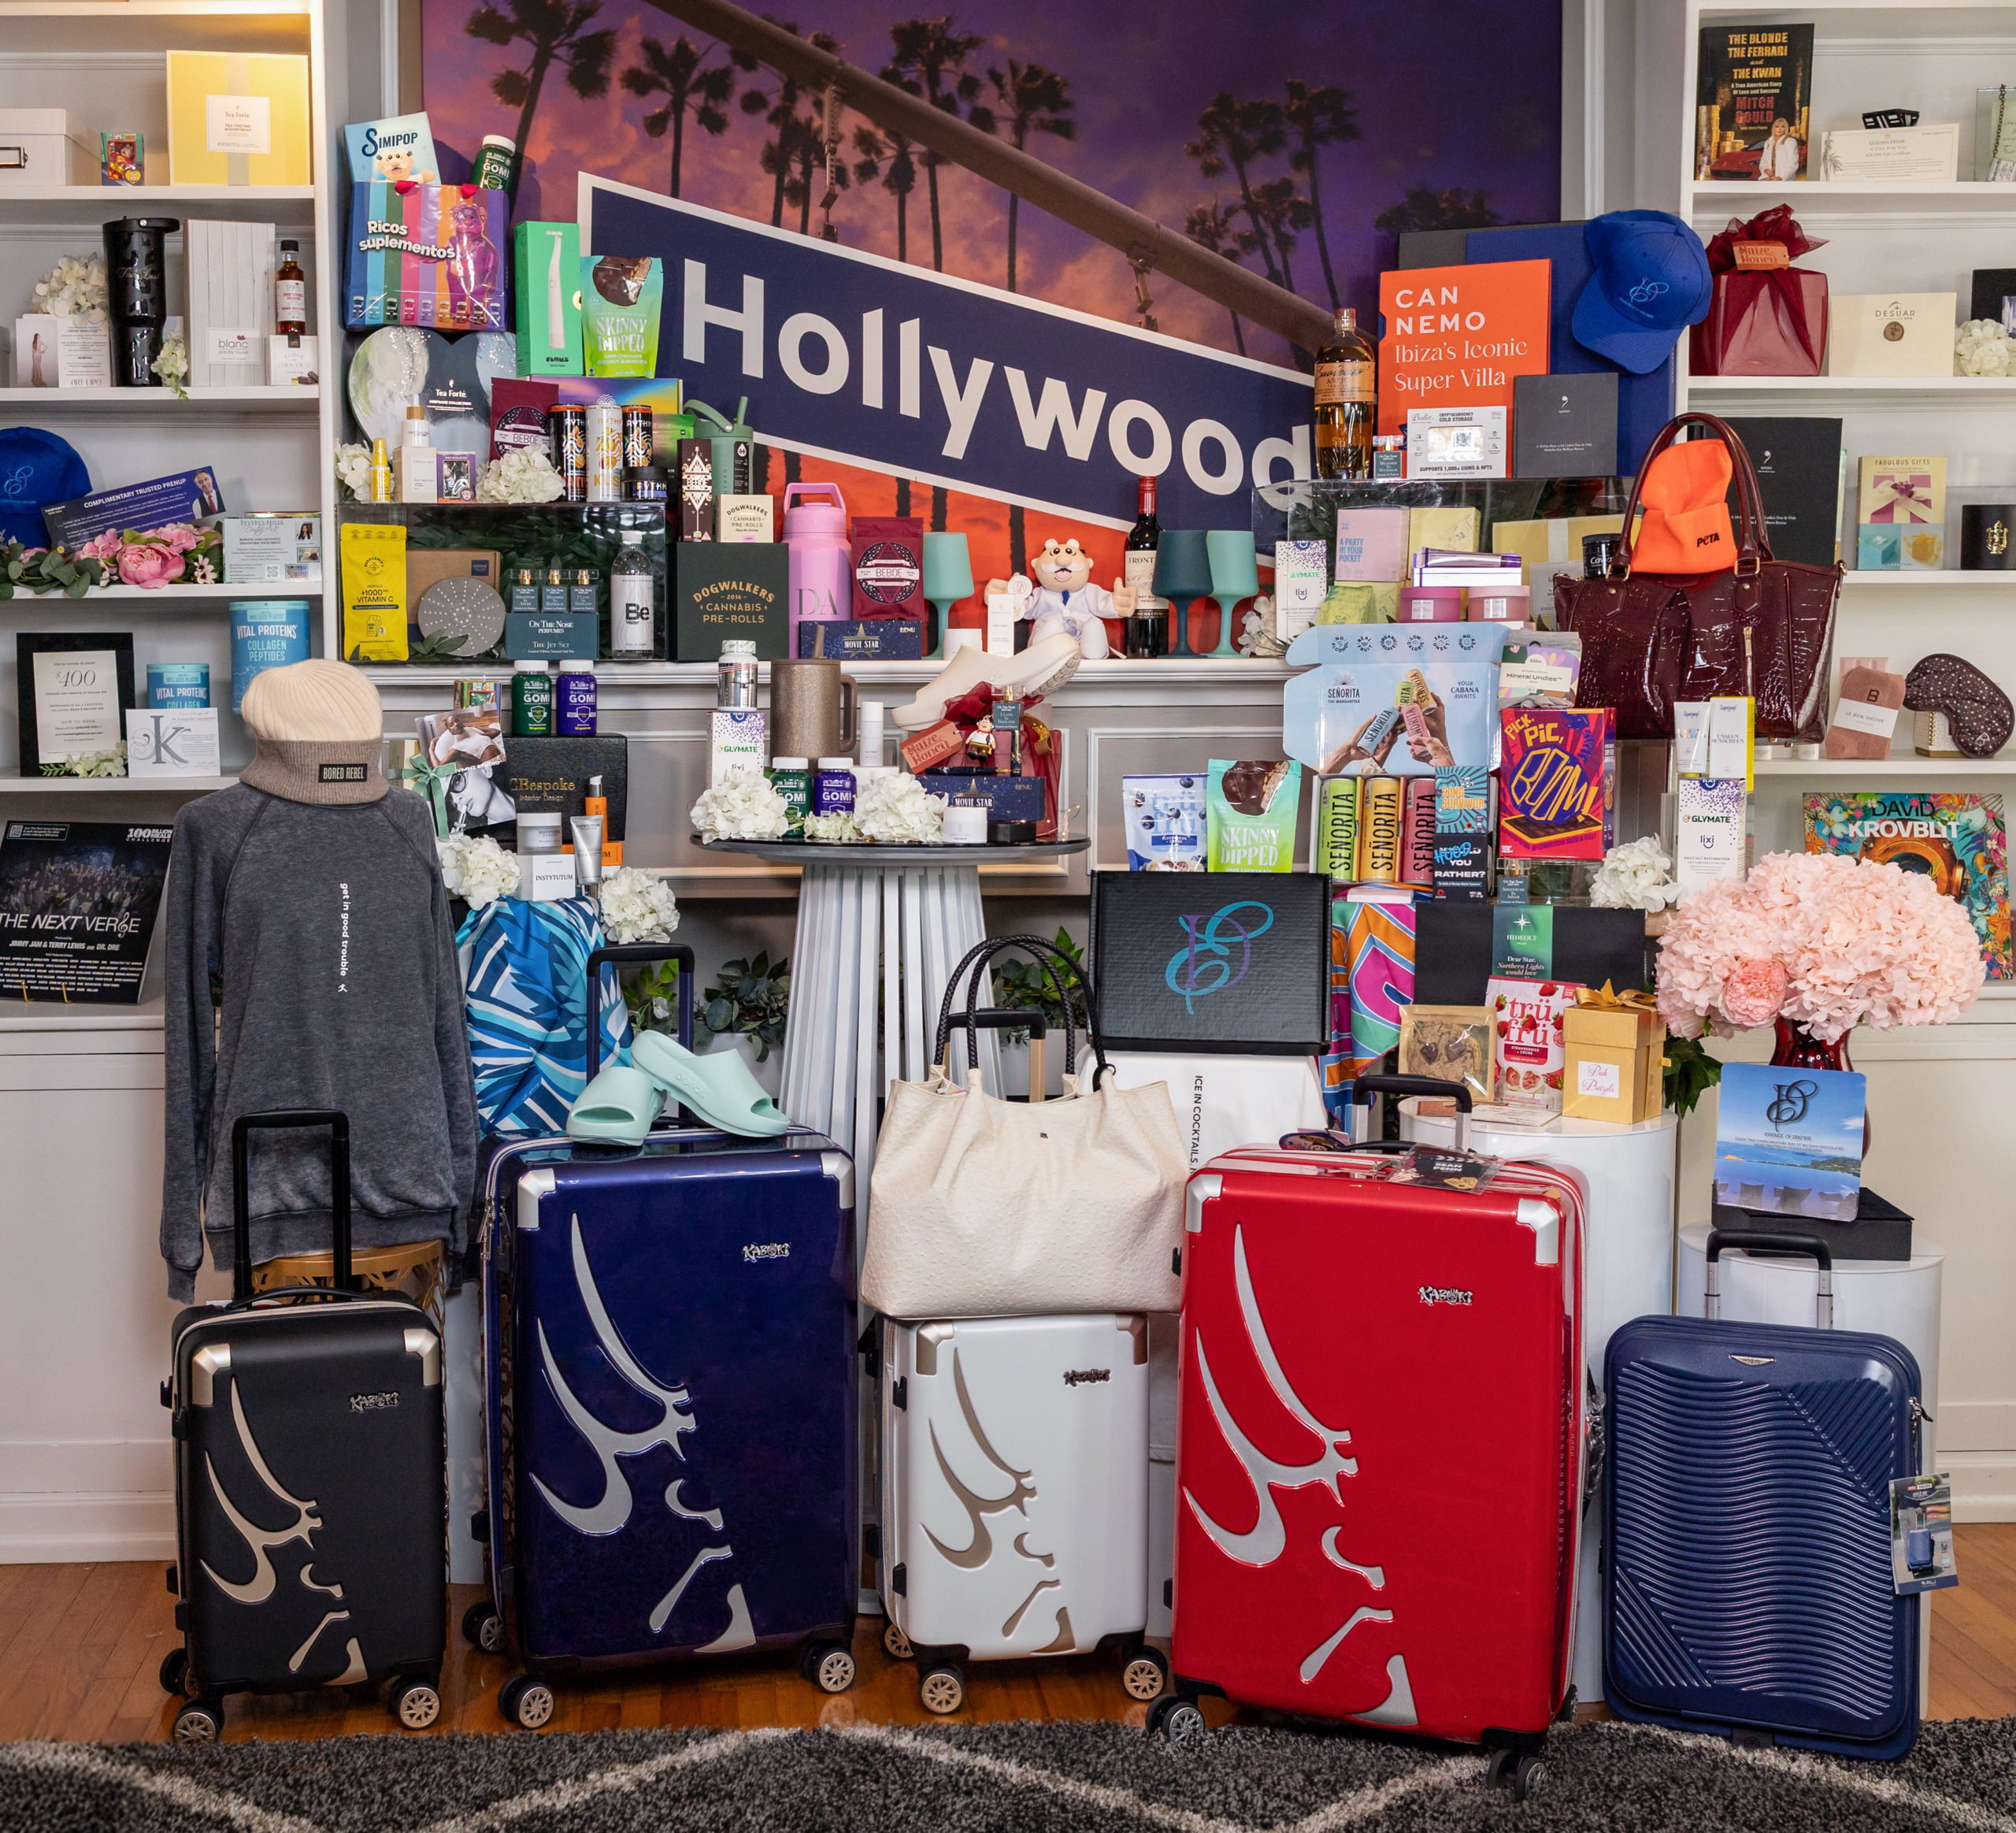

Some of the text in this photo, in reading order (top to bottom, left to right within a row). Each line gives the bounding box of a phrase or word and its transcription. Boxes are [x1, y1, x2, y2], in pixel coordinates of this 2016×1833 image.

[1728, 32, 1788, 45] THE BLONDE
[1728, 46, 1788, 58] THE FERRARI
[1733, 67, 1781, 79] THE KWAN
[1736, 97, 1774, 109] MITCH
[1735, 111, 1774, 124] GOULD
[483, 163, 510, 179] GOMI
[367, 220, 408, 236] Ricos
[359, 235, 456, 260] suplementos
[1395, 286, 1458, 309] CAN
[596, 317, 647, 336] SKINNY
[1396, 312, 1485, 336] NEMO
[219, 339, 249, 348] blanc
[598, 334, 645, 352] DIPPED
[1395, 337, 1528, 364] Ibiza's Iconic
[683, 257, 1309, 513] Hollywood
[1394, 371, 1506, 397] Super Villa
[514, 433, 539, 445] BEBOE
[83, 490, 135, 509] COMPLIMENTARY
[135, 484, 162, 498] TRUSTED
[162, 478, 186, 493] PRENUP
[727, 505, 768, 516] DOGWALKERS
[364, 557, 384, 567] BEEKEEPER'S
[1339, 554, 1361, 562] POCKET
[876, 569, 902, 577] BEBOE
[693, 581, 775, 603] DOGWALKERS
[706, 603, 761, 611] CANNABIS
[796, 588, 840, 615] DA
[626, 603, 650, 620] Be
[703, 615, 764, 623] PRE-ROLLS
[237, 625, 297, 640] VITAL PROTEINS
[248, 640, 286, 651] COLLAGEN
[864, 640, 879, 648] STAR
[1332, 641, 1348, 652] ALCOHOL
[1407, 642, 1424, 651] CALORIE
[1433, 642, 1449, 651] ONSET
[249, 651, 285, 661] PEPTIDES
[56, 669, 95, 687] $400
[156, 688, 207, 700] VITAL PROTEINS
[524, 694, 550, 703] GOMI
[569, 694, 595, 703] GOMI
[1328, 688, 1360, 699] SEÑORITA
[911, 740, 951, 765] Honey
[323, 767, 364, 780] BORED REBEL
[822, 792, 851, 801] GOMI
[1442, 787, 1464, 798] SONG
[955, 798, 992, 807] MOVIE STAR
[1442, 798, 1485, 810] SURVIVOR
[1872, 800, 1936, 817] DAVID
[128, 829, 151, 838] 100
[1222, 827, 1280, 845] SKINNY
[1326, 793, 1354, 871] SEÑORITA
[1369, 793, 1396, 871] SEÑORITA
[1849, 821, 1961, 838] KROVBLIT
[1700, 835, 1714, 844] lixi
[1221, 845, 1278, 866] DIPPED
[1434, 842, 1471, 865] HOOD
[340, 883, 350, 976] get in good trouble
[1509, 998, 1552, 1021] trü
[1190, 1076, 1203, 1165] ICE IN COCKTAILS.
[742, 1243, 790, 1260] KABUKI
[1419, 1285, 1473, 1304] KABUKI
[349, 1392, 399, 1412] KABUKI
